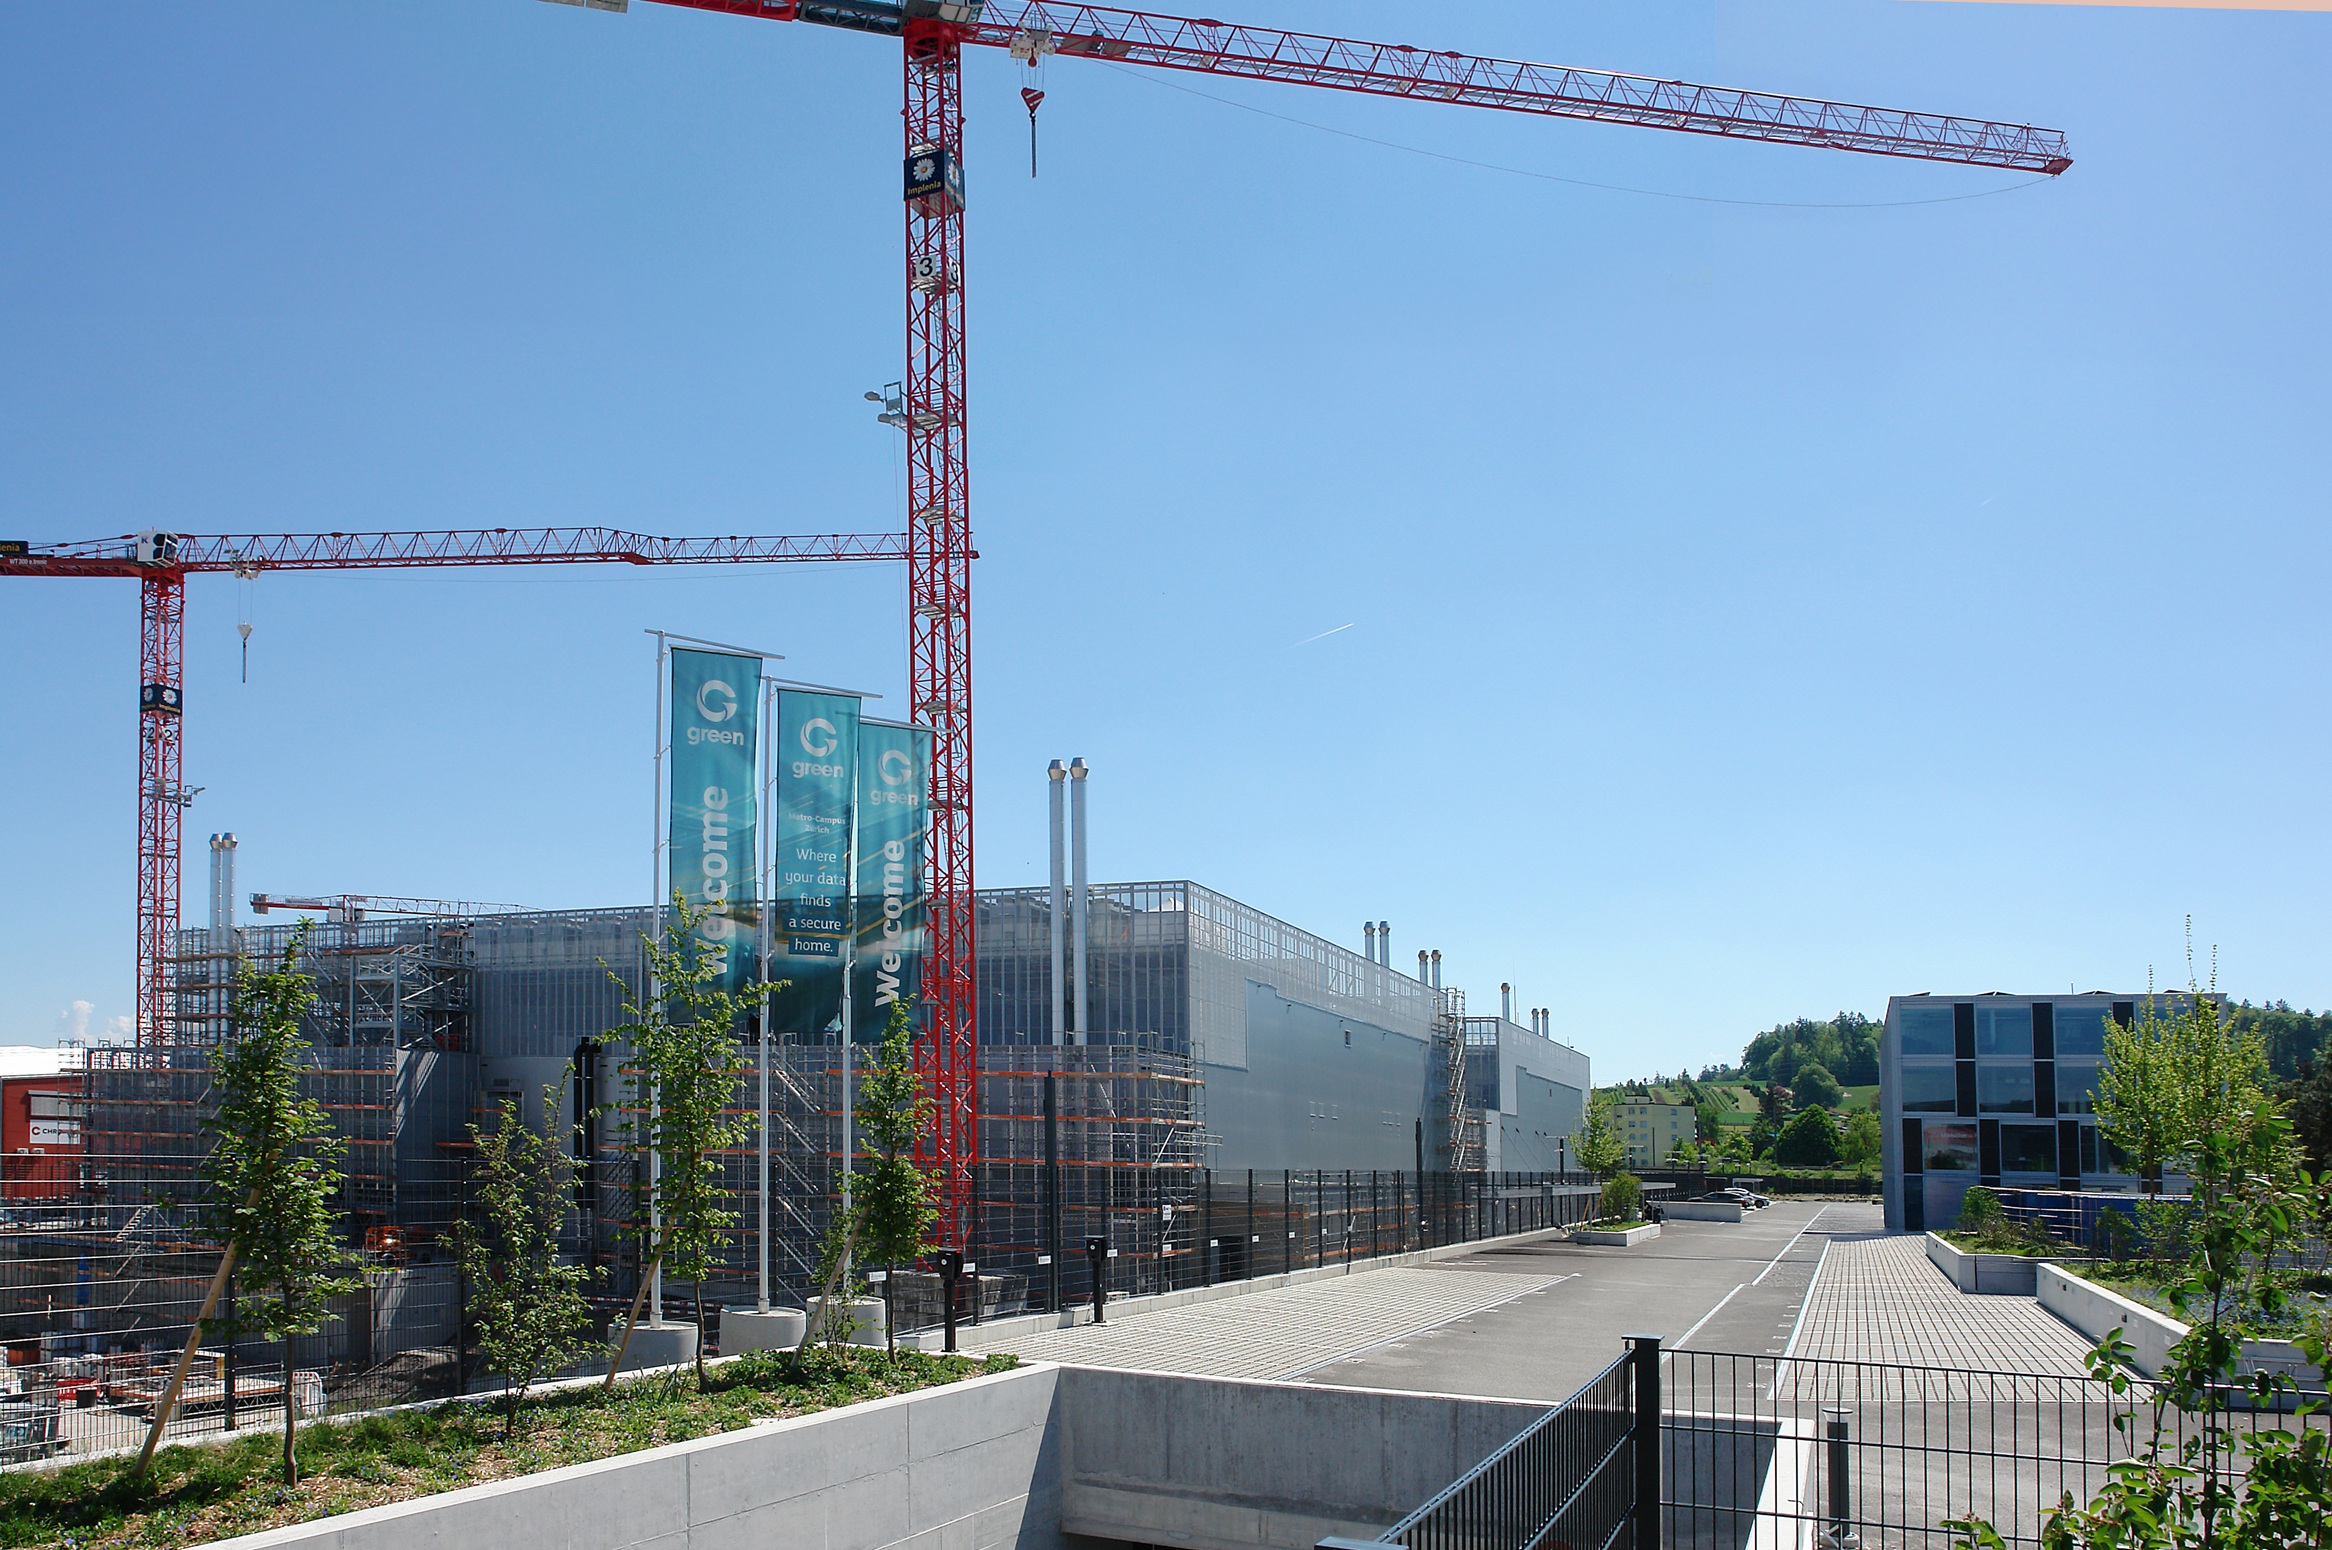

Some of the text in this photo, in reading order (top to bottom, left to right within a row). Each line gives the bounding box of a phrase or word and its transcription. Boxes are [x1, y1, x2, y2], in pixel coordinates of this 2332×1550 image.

[907, 180, 941, 195] Implenia
[919, 257, 933, 277] 3
[687, 726, 744, 746] green
[792, 760, 844, 779] green
[870, 789, 918, 806] green
[788, 812, 846, 826] Metro-Campus
[796, 848, 837, 863] Where
[785, 872, 846, 887] your data
[800, 893, 831, 907] finds
[788, 917, 841, 931] a secure
[874, 839, 905, 1008] Welcome
[794, 938, 833, 953] home.
